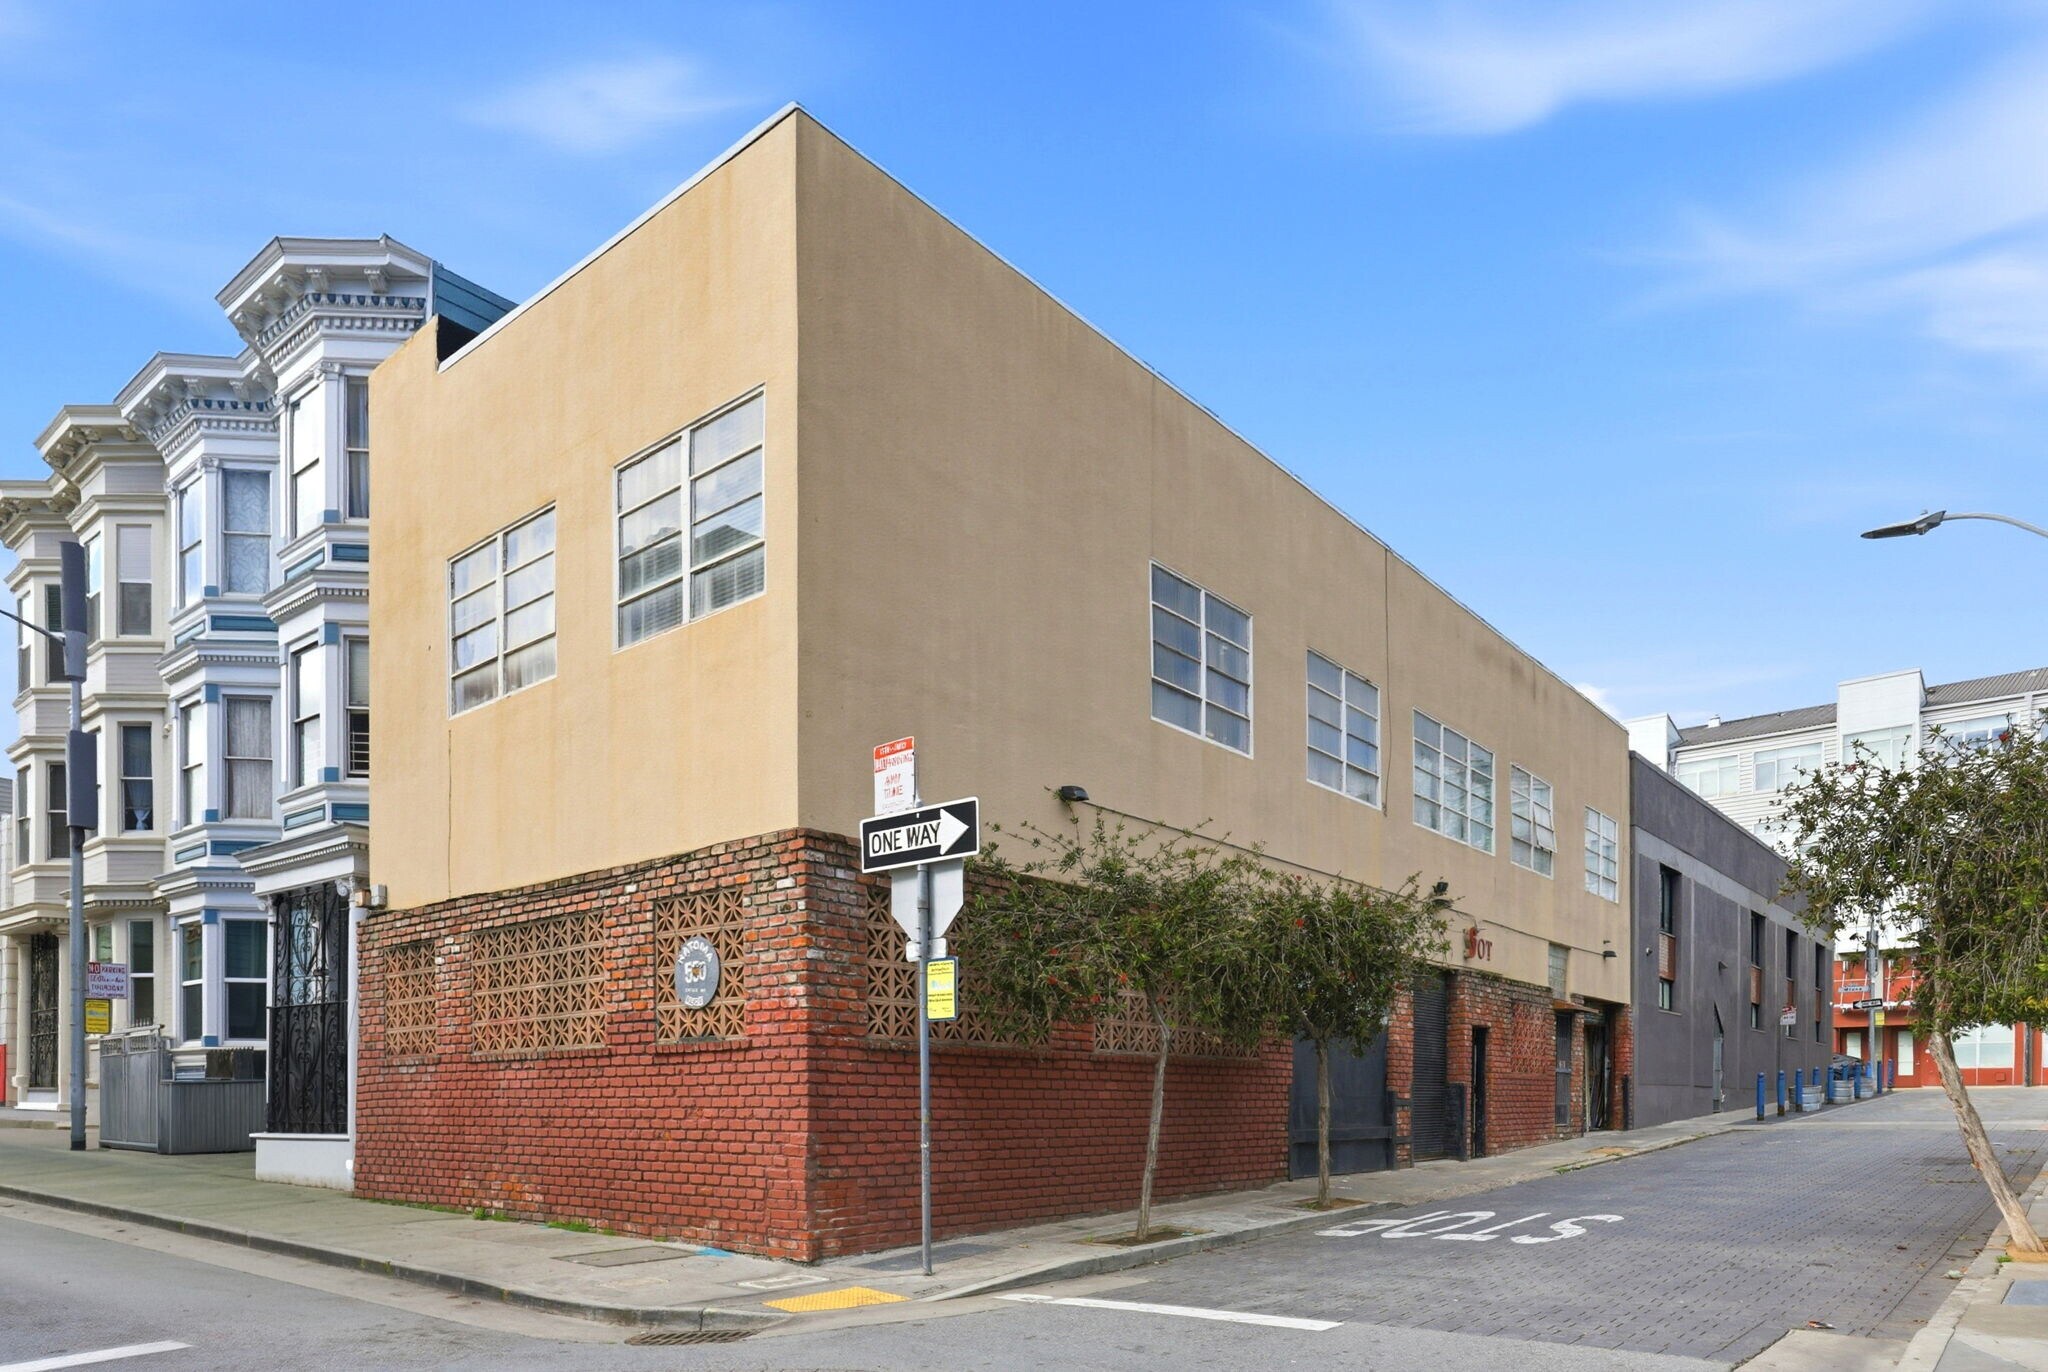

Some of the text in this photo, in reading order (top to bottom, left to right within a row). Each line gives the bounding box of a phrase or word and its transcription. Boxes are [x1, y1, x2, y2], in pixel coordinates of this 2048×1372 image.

[871, 821, 941, 855] ONE WAY
[89, 963, 100, 974] NO
[1314, 1210, 1625, 1245] STOP
